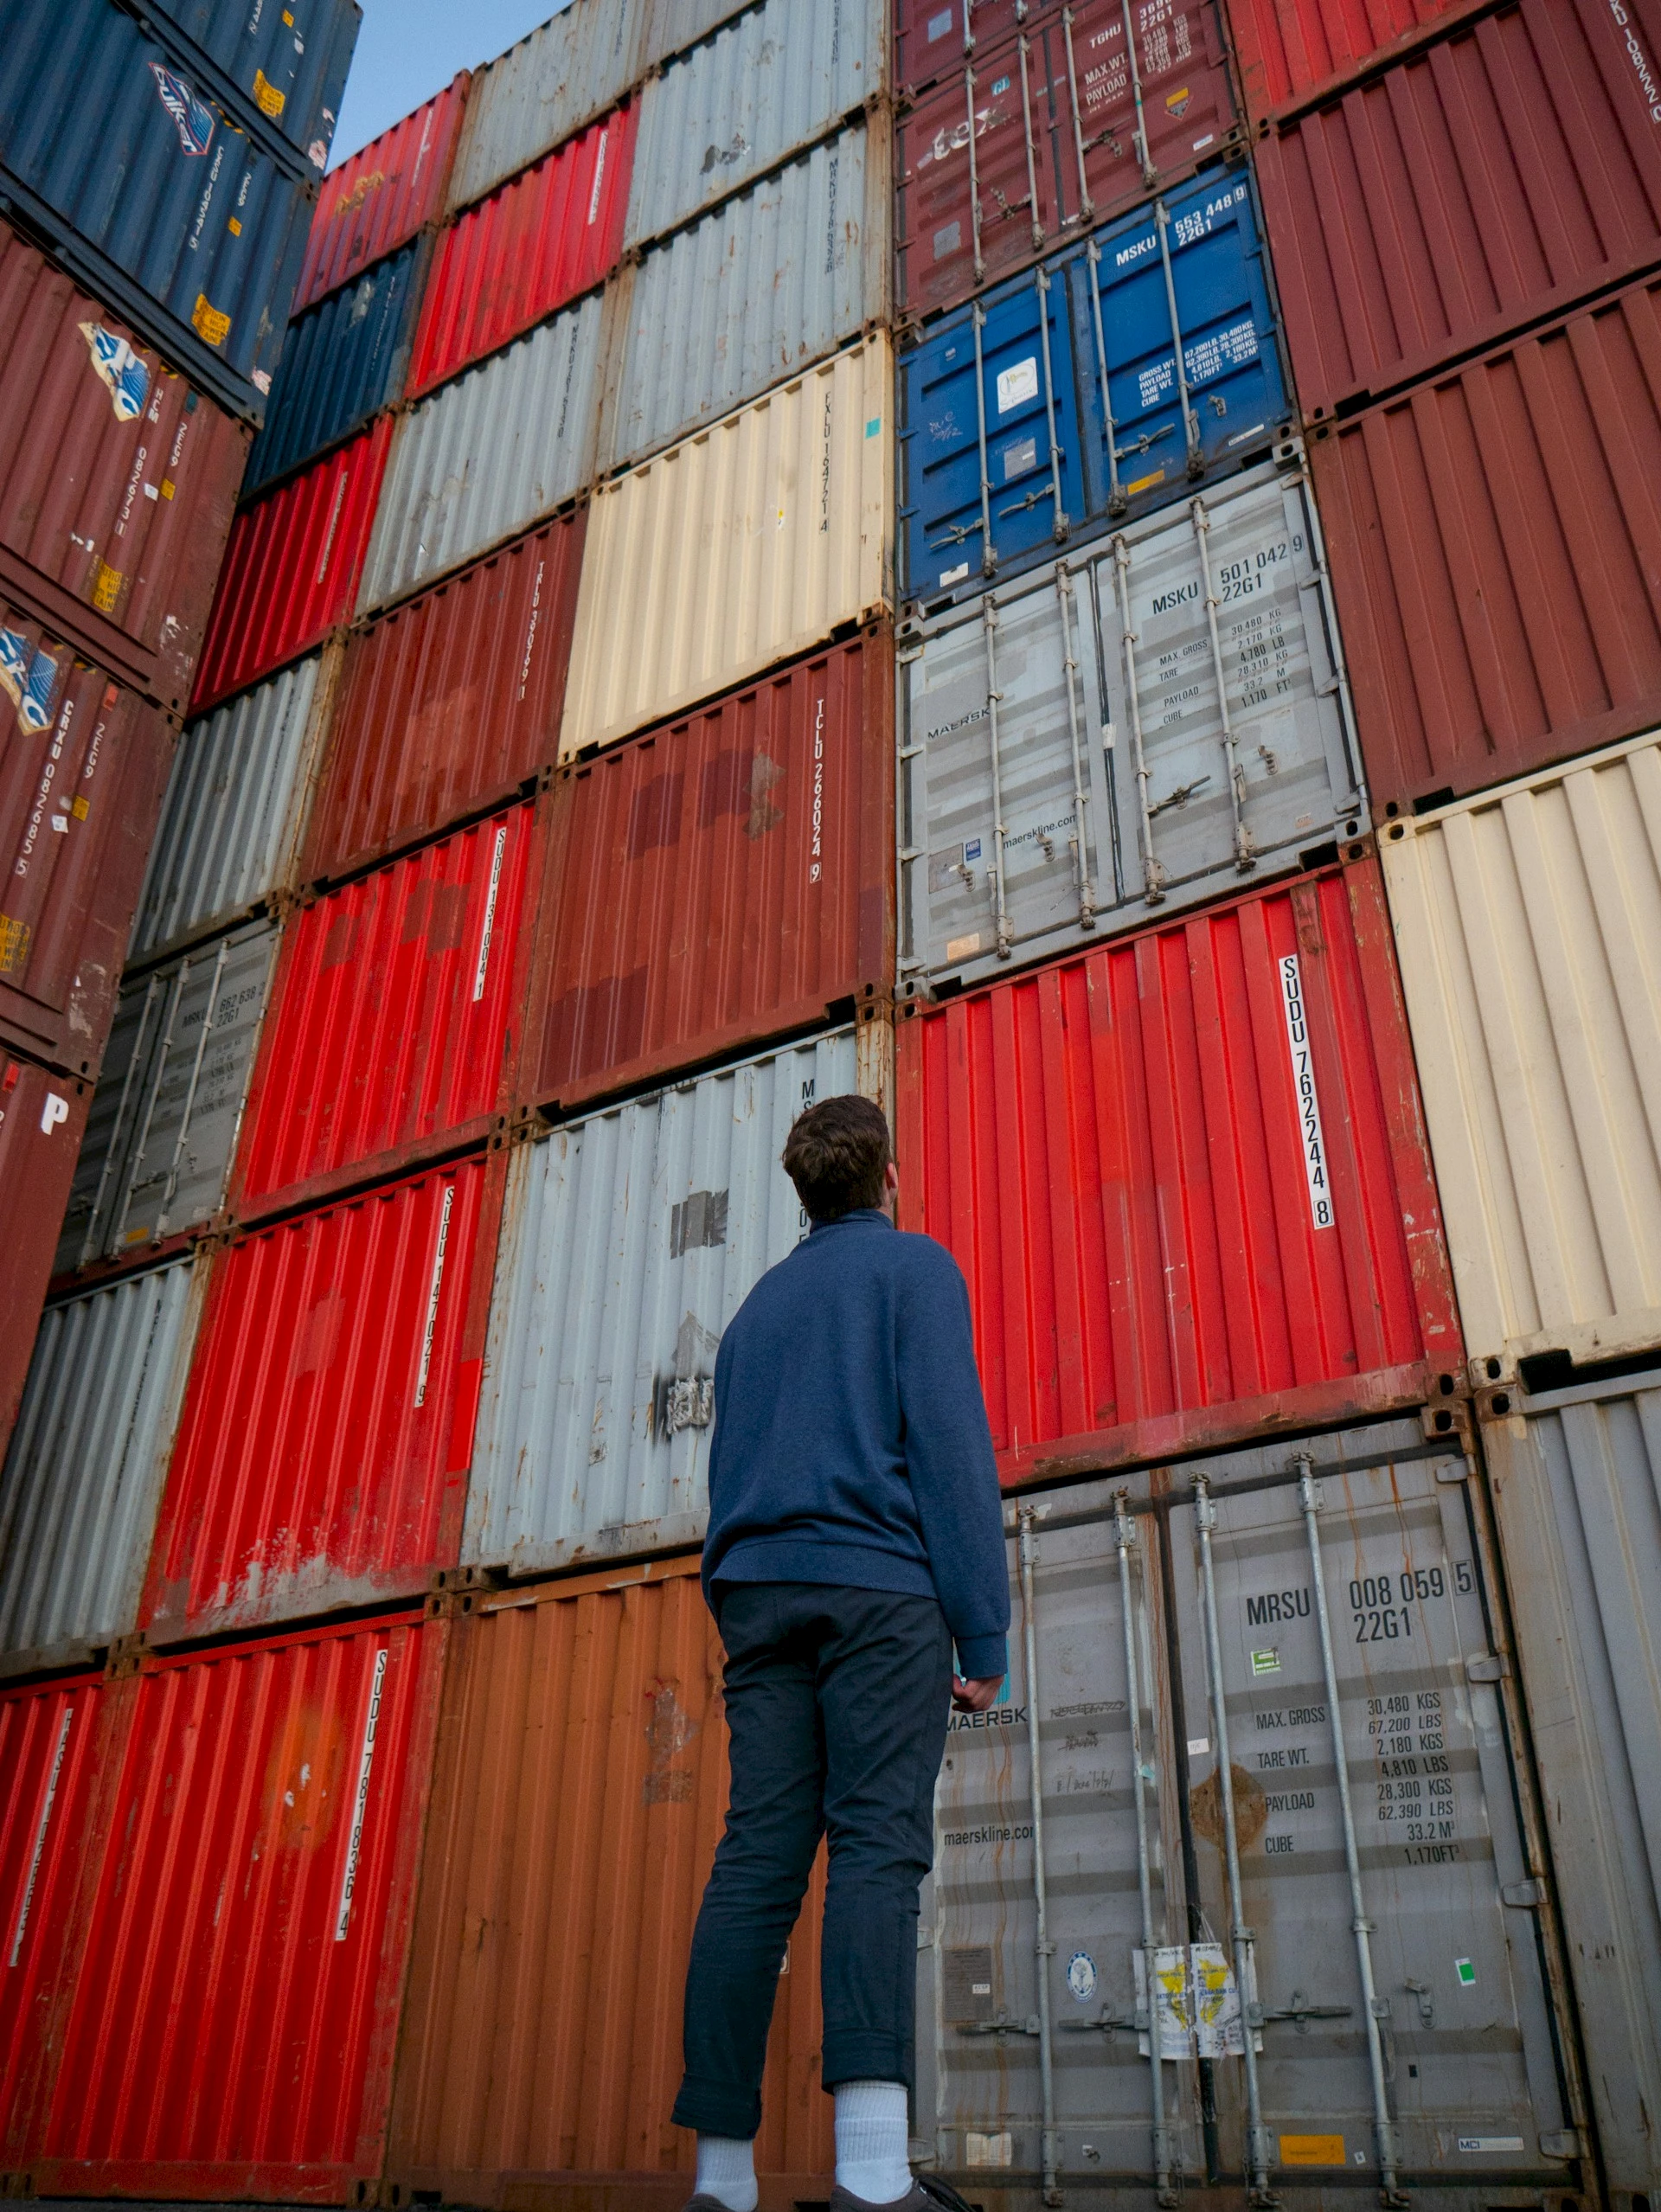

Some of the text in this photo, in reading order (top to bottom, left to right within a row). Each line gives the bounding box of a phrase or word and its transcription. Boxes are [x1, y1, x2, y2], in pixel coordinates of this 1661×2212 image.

[1089, 22, 1121, 48] TGHU
[1140, 4, 1172, 33] 22G1
[1624, 28, 1658, 104] 108222
[1086, 74, 1127, 106] PAYLOAD
[1116, 186, 1245, 266] MSKU 553 448 9
[1178, 218, 1212, 247] 22G1
[1138, 365, 1162, 381] GROSS
[1163, 358, 1177, 371] WT.
[1139, 369, 1171, 390] PAYLOAD
[1141, 385, 1159, 398] TARE
[1159, 379, 1173, 391] WT.
[1141, 394, 1159, 407] CUBE
[170, 422, 188, 467] 2EG9
[122, 446, 147, 520] 082673
[821, 443, 830, 515] 164721
[532, 561, 545, 607] TRLU
[1152, 535, 1303, 614] MSKU 501 042 9
[1222, 573, 1262, 602] 22G1
[1159, 651, 1179, 666] MAX.
[1183, 639, 1208, 657] GROSS
[1268, 608, 1281, 620] KG
[1159, 667, 1179, 683] TARE
[1269, 624, 1282, 637] KG
[1273, 636, 1286, 650] LB
[1164, 686, 1199, 707] PAYLOAD
[1276, 650, 1288, 662] KG
[927, 706, 991, 740] MAERSK
[1163, 709, 1183, 725] CUBE
[85, 722, 105, 779] 2EG9
[16, 699, 74, 876] CRXU 082685 5
[811, 698, 824, 882] TCLU 266024 9
[492, 829, 506, 884] SUDU
[478, 888, 496, 976] 131004
[1284, 956, 1331, 1225] SUDU 762244 8
[418, 1188, 454, 1404] SUDU 147021 9
[1247, 1562, 1472, 1626] MRSU 008 059 5
[1352, 1606, 1412, 1644] 22G1
[1256, 1711, 1287, 1730] MAX.
[1289, 1706, 1326, 1726] GROSS
[1416, 1692, 1441, 1709] KGS
[1418, 1713, 1441, 1730] LBS
[1257, 1732, 1444, 1770] TARE WT. 2,180 KGS
[1381, 1755, 1449, 1779] 4,810 LBS
[338, 1651, 388, 1938] SUDU 781836 4
[1265, 1778, 1453, 1813] PAYLOAD 28,300 KGS
[1429, 1800, 1453, 1817] LBS
[1266, 1835, 1294, 1855] CUBE
[1407, 1823, 1436, 1842] 33.2
[1459, 2140, 1481, 2151] MCI
